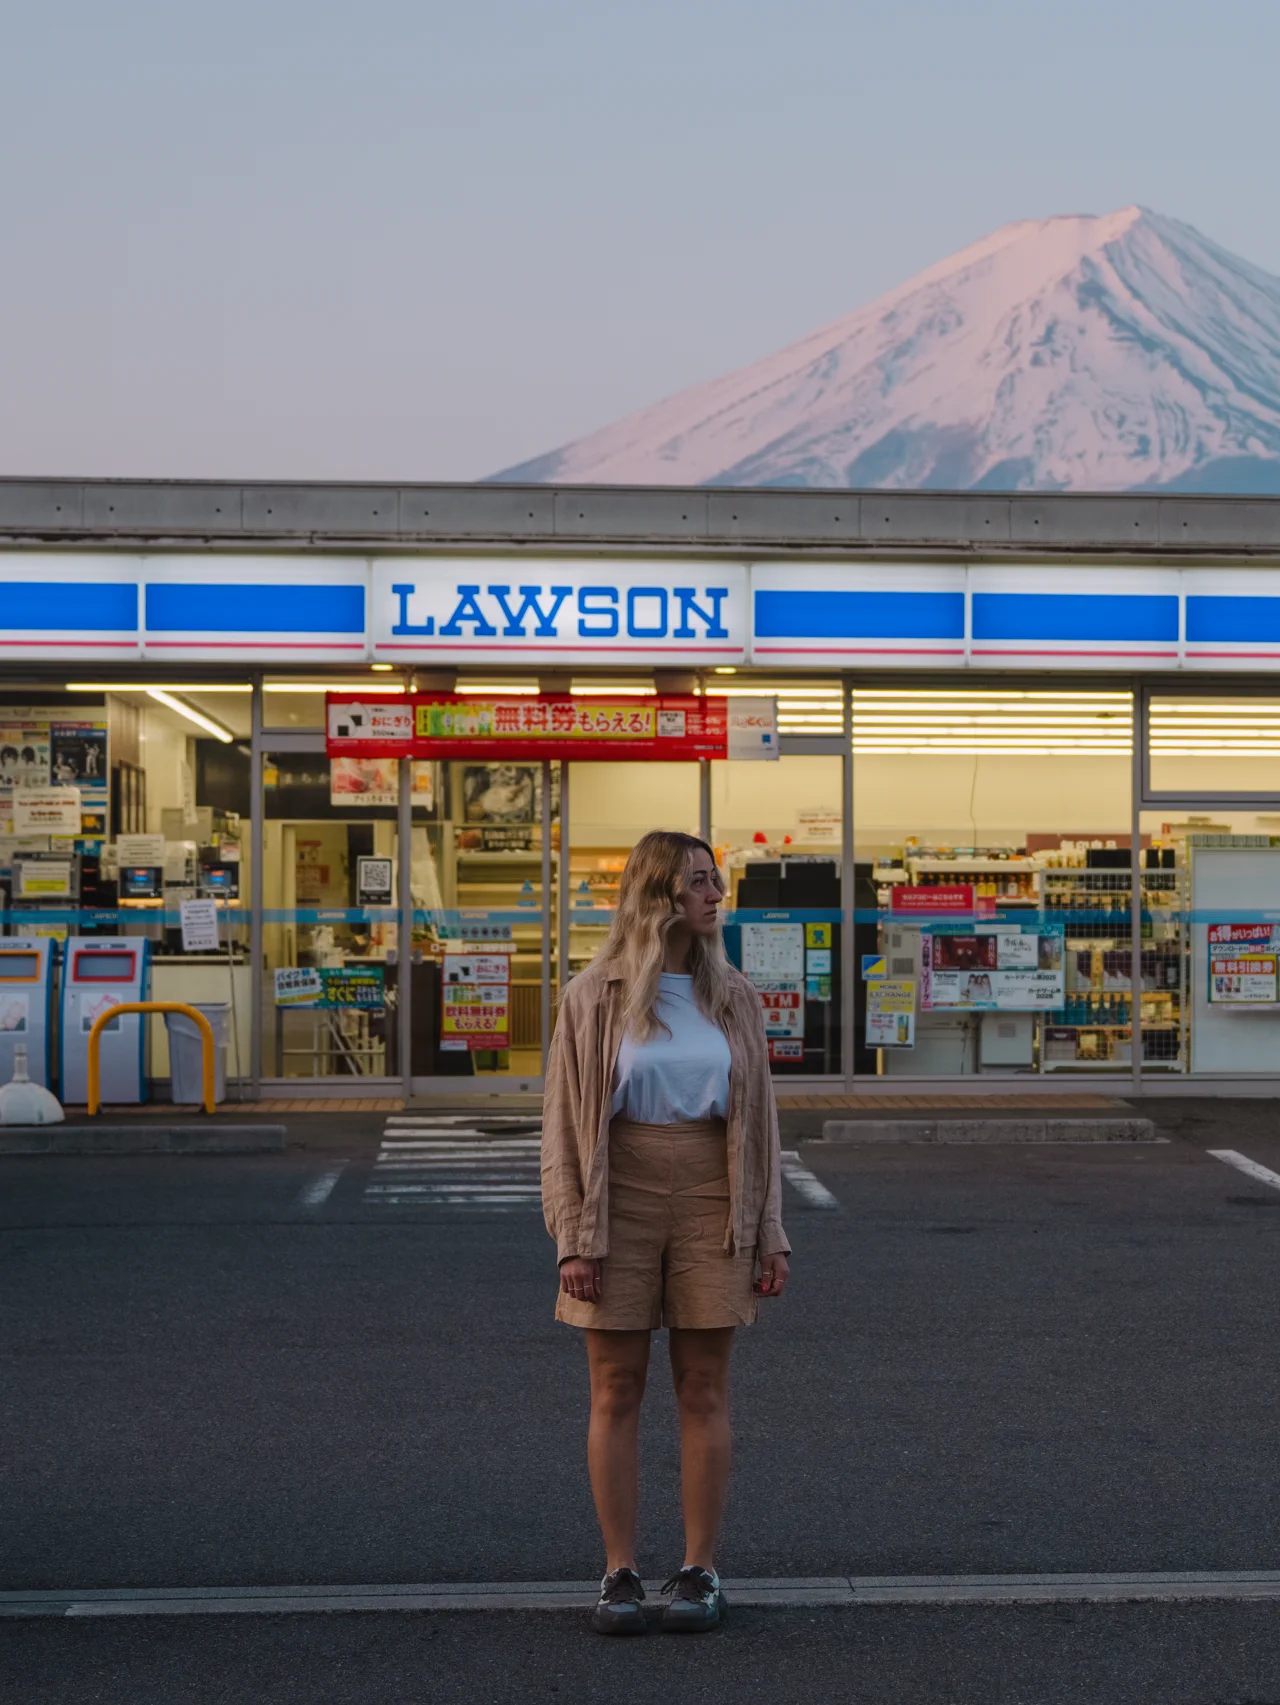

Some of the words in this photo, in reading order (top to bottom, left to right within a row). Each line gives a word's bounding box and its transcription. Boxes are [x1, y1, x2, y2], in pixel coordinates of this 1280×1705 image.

[392, 584, 729, 639] LAWSON
[371, 716, 412, 728] おにぎり
[753, 983, 797, 991] ーソン銀行
[870, 991, 912, 999] EXCHANGE
